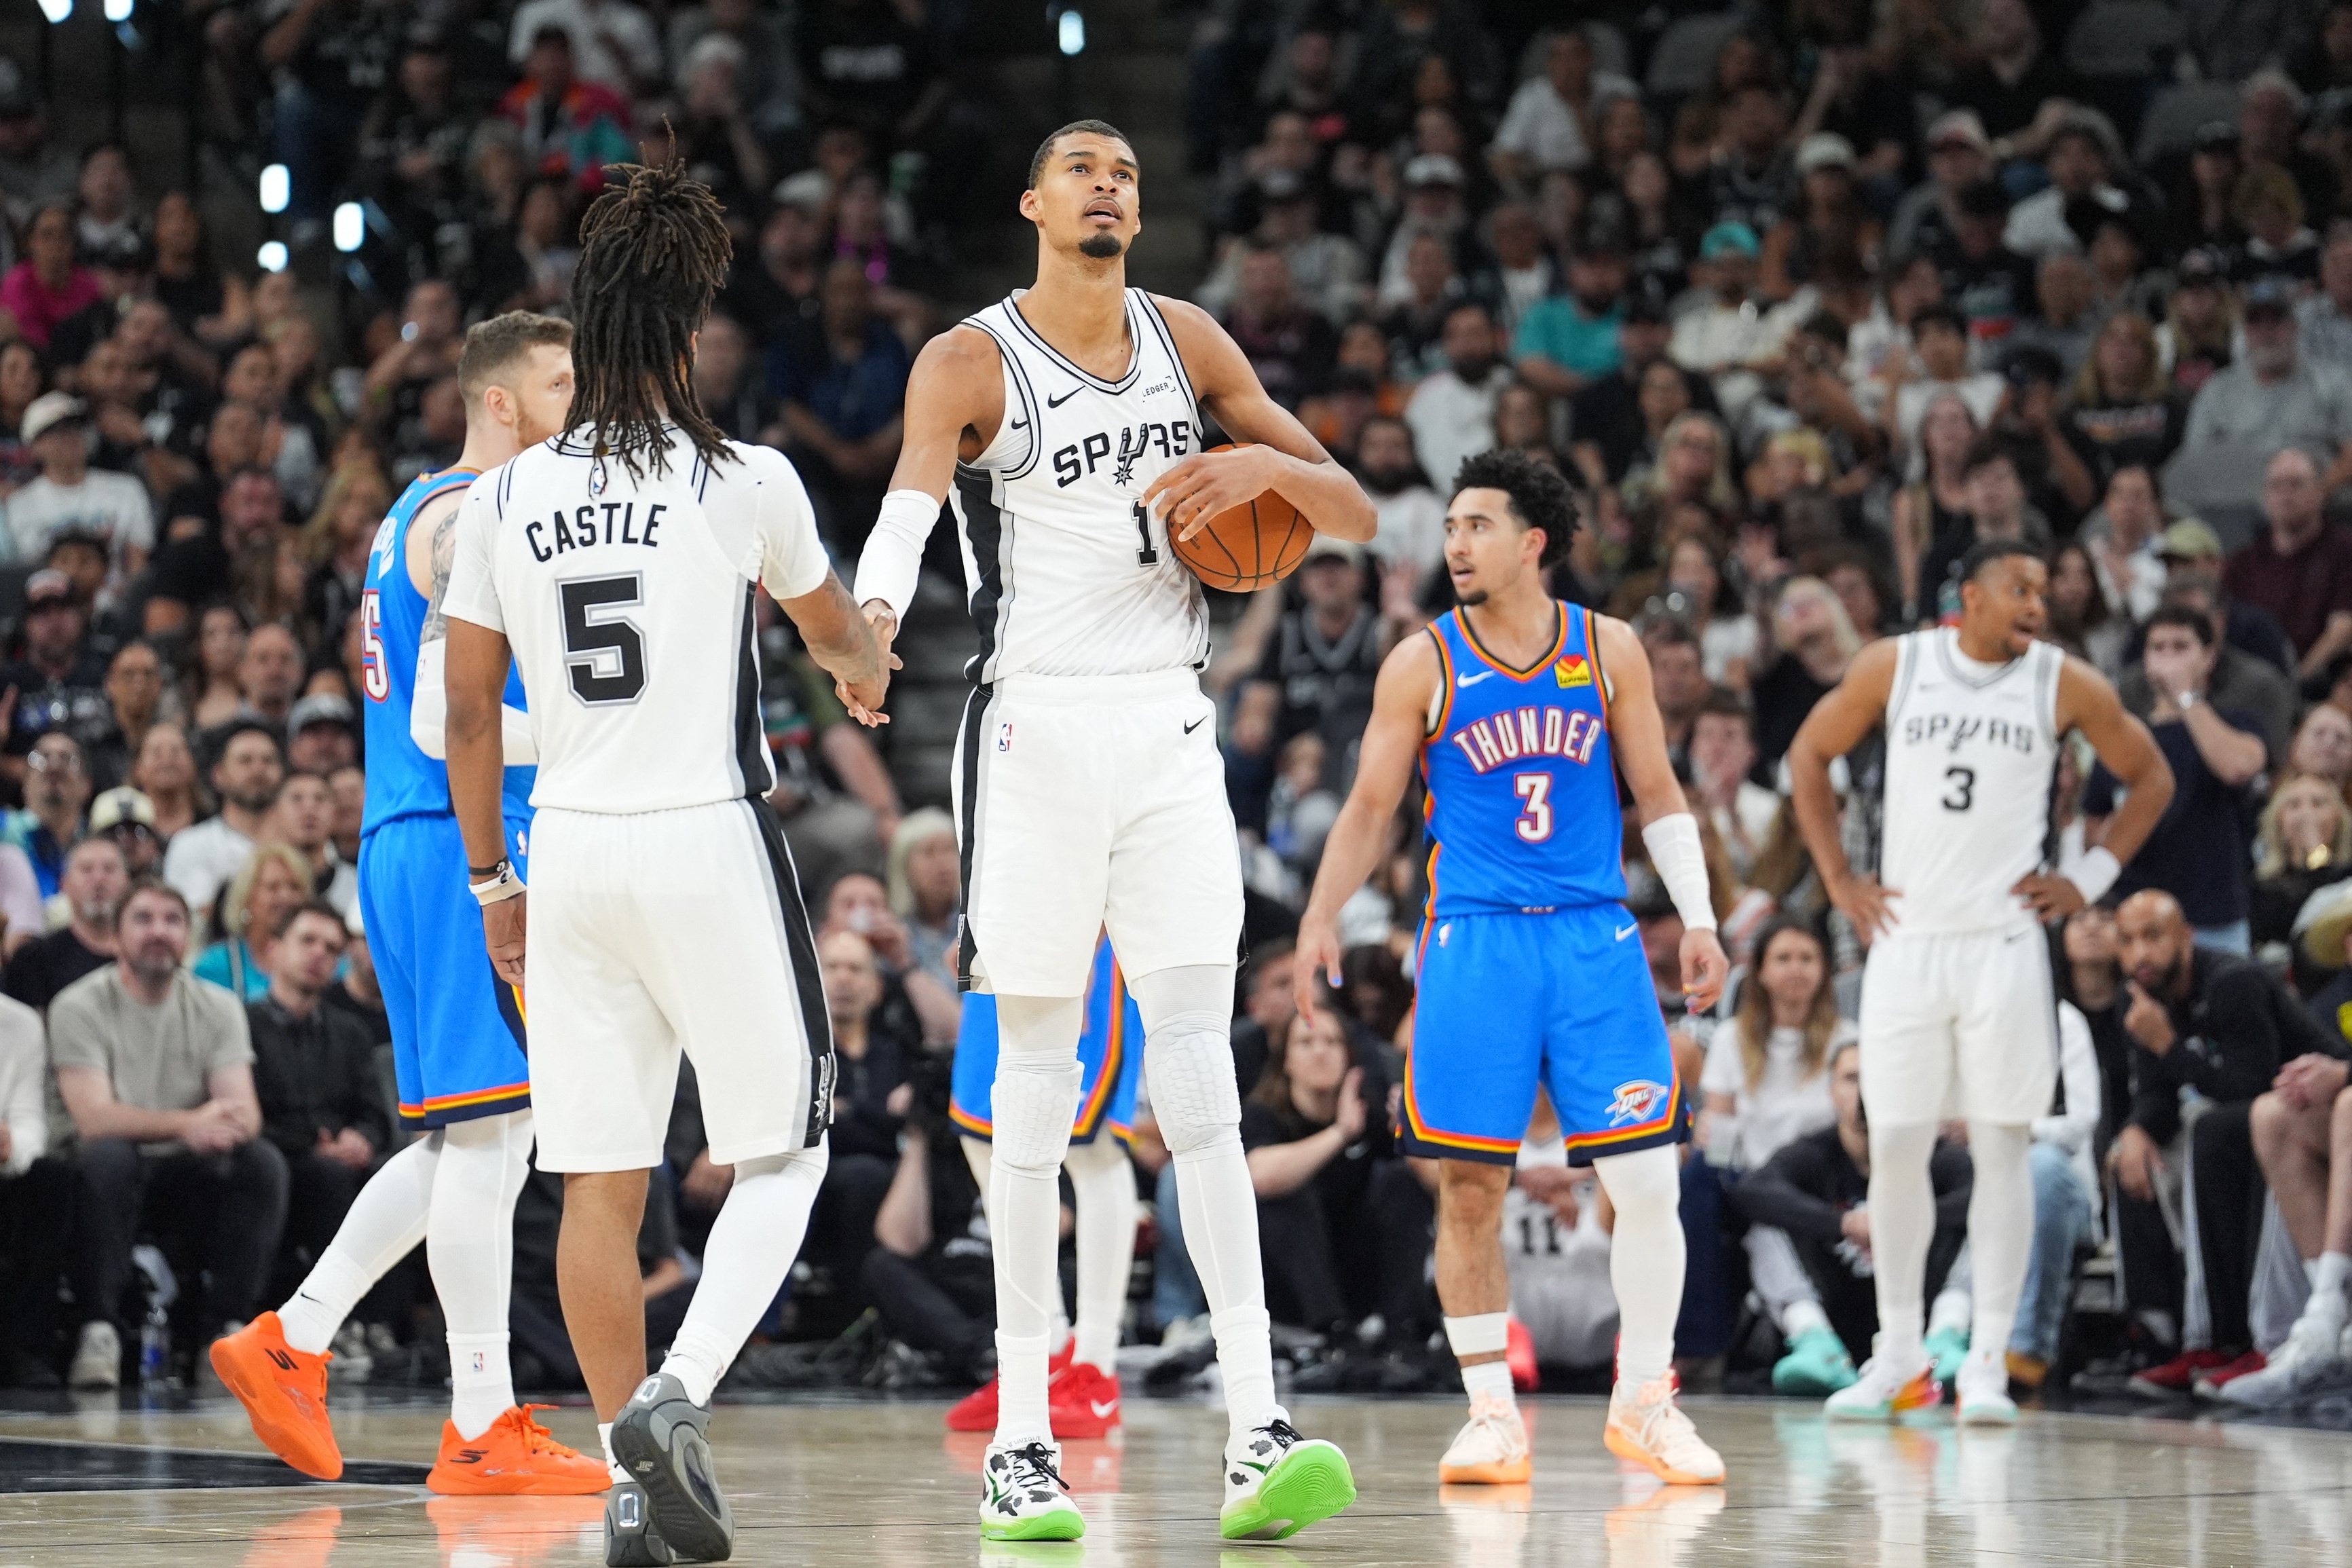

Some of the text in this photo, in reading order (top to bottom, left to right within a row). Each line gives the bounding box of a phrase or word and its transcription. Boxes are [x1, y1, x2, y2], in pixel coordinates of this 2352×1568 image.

[1142, 382, 1169, 397] LEDGER
[1053, 420, 1189, 489] SPURS
[525, 502, 667, 563] CASTLE
[1130, 498, 1159, 568] 1
[554, 570, 650, 709] 5
[1452, 705, 1603, 775] THUNDER
[1905, 713, 2034, 755] SPURS
[1514, 772, 1554, 845] 3
[1941, 764, 1976, 813] 3
[1516, 1214, 1563, 1256] 11
